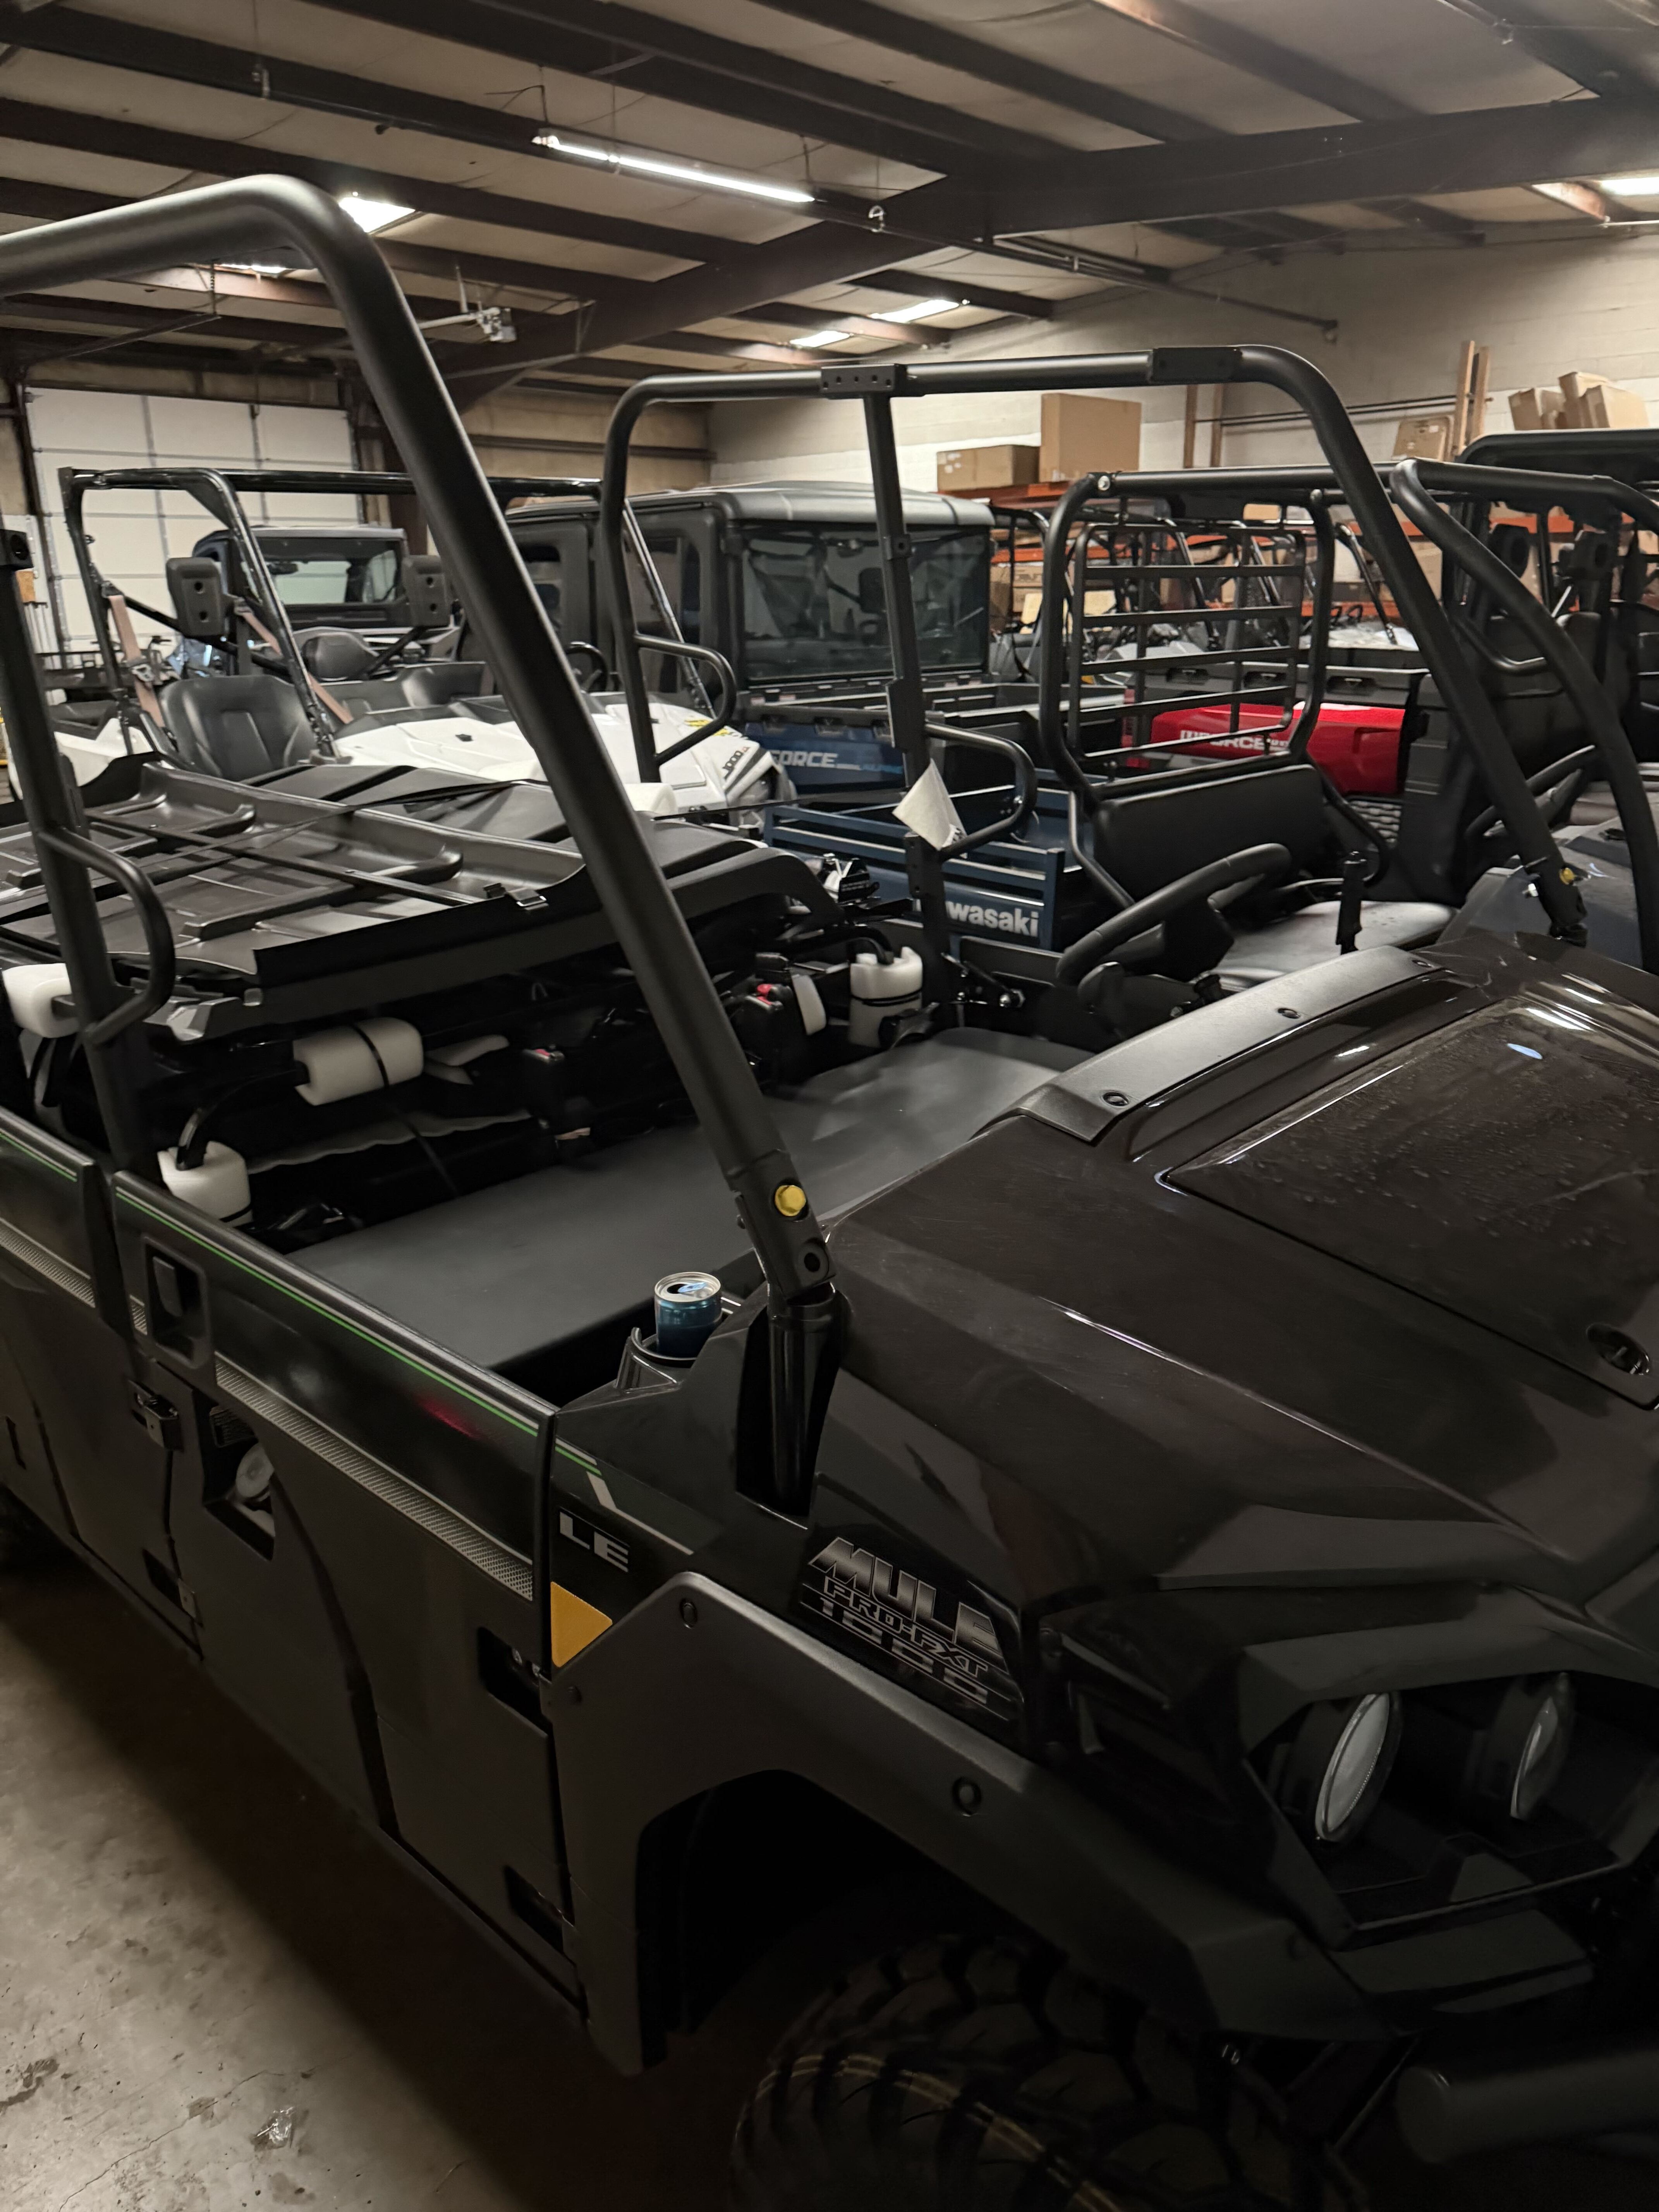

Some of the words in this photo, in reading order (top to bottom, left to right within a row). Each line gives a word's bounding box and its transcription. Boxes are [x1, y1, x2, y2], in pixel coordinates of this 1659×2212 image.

[945, 900, 1039, 937] wasaki
[560, 1511, 628, 1572] LE
[808, 1537, 1009, 1675] MULE
[820, 1597, 988, 1704] 1000
